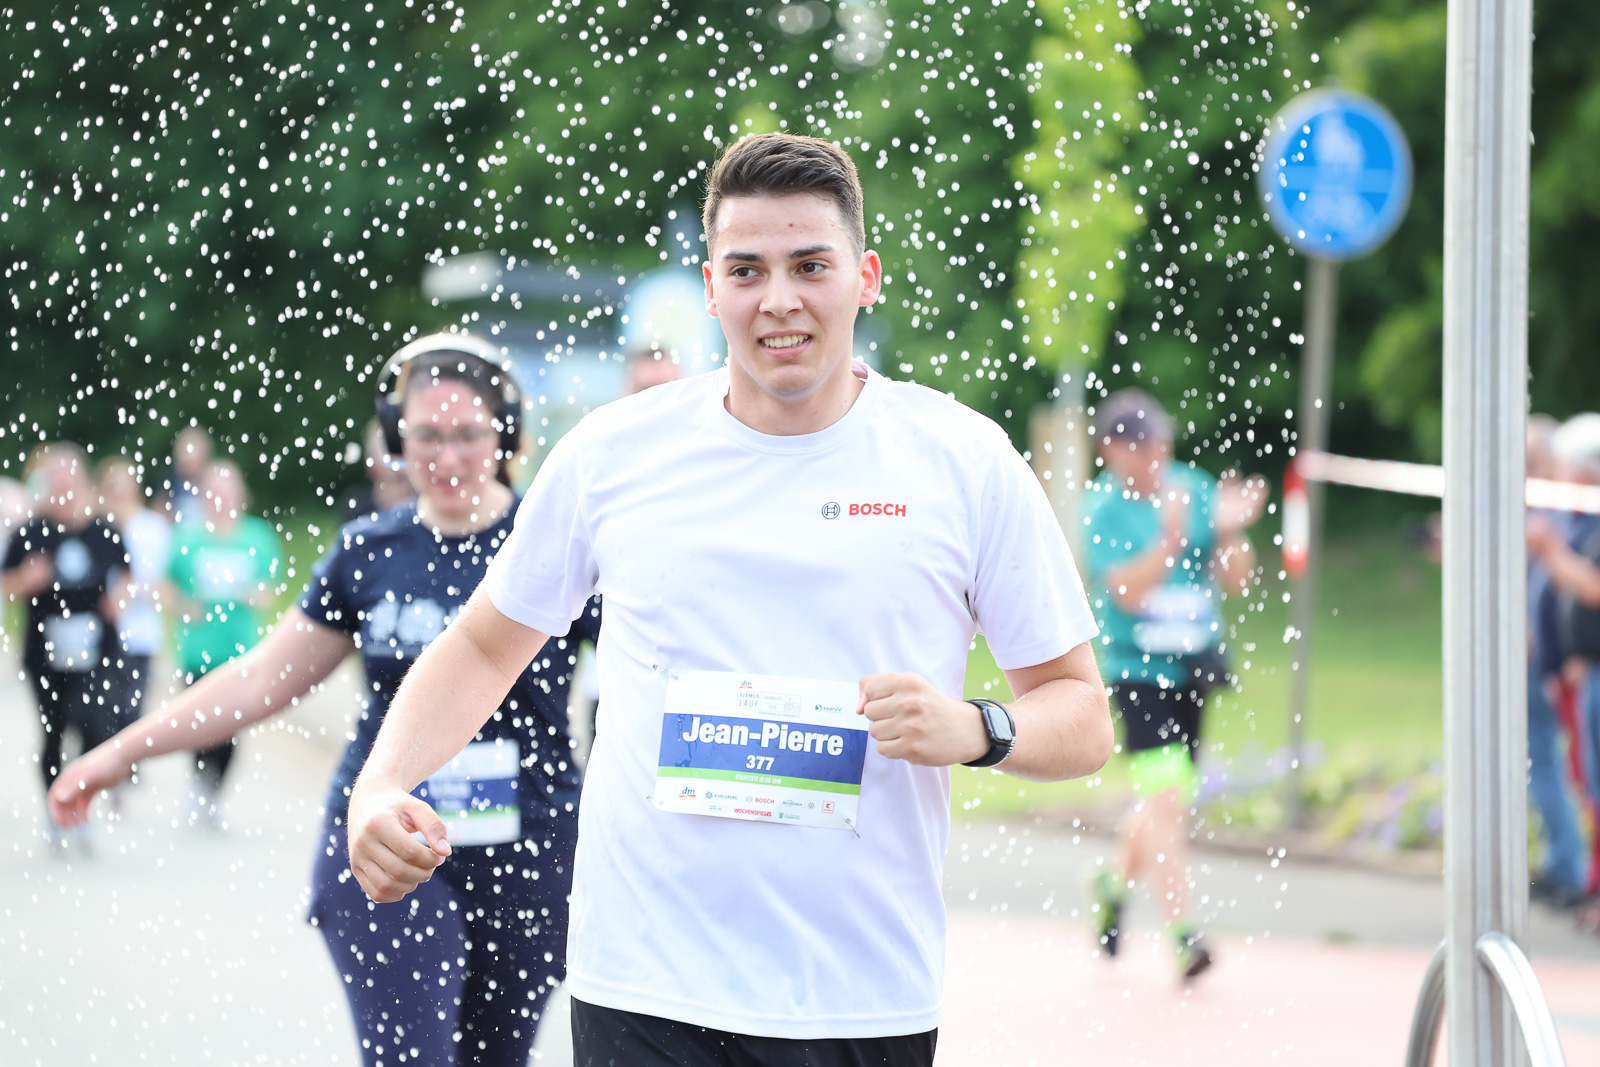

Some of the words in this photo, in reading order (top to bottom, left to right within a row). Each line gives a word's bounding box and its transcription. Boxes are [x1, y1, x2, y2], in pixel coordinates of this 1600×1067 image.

[848, 503, 906, 517] BOSCH
[738, 699, 759, 708] LAUF
[682, 716, 844, 756] Jean-Pierre
[745, 755, 775, 771] 377
[681, 786, 696, 795] dm
[754, 797, 775, 805] BOSCH
[733, 808, 772, 817] WOCHENSPIEGEL
